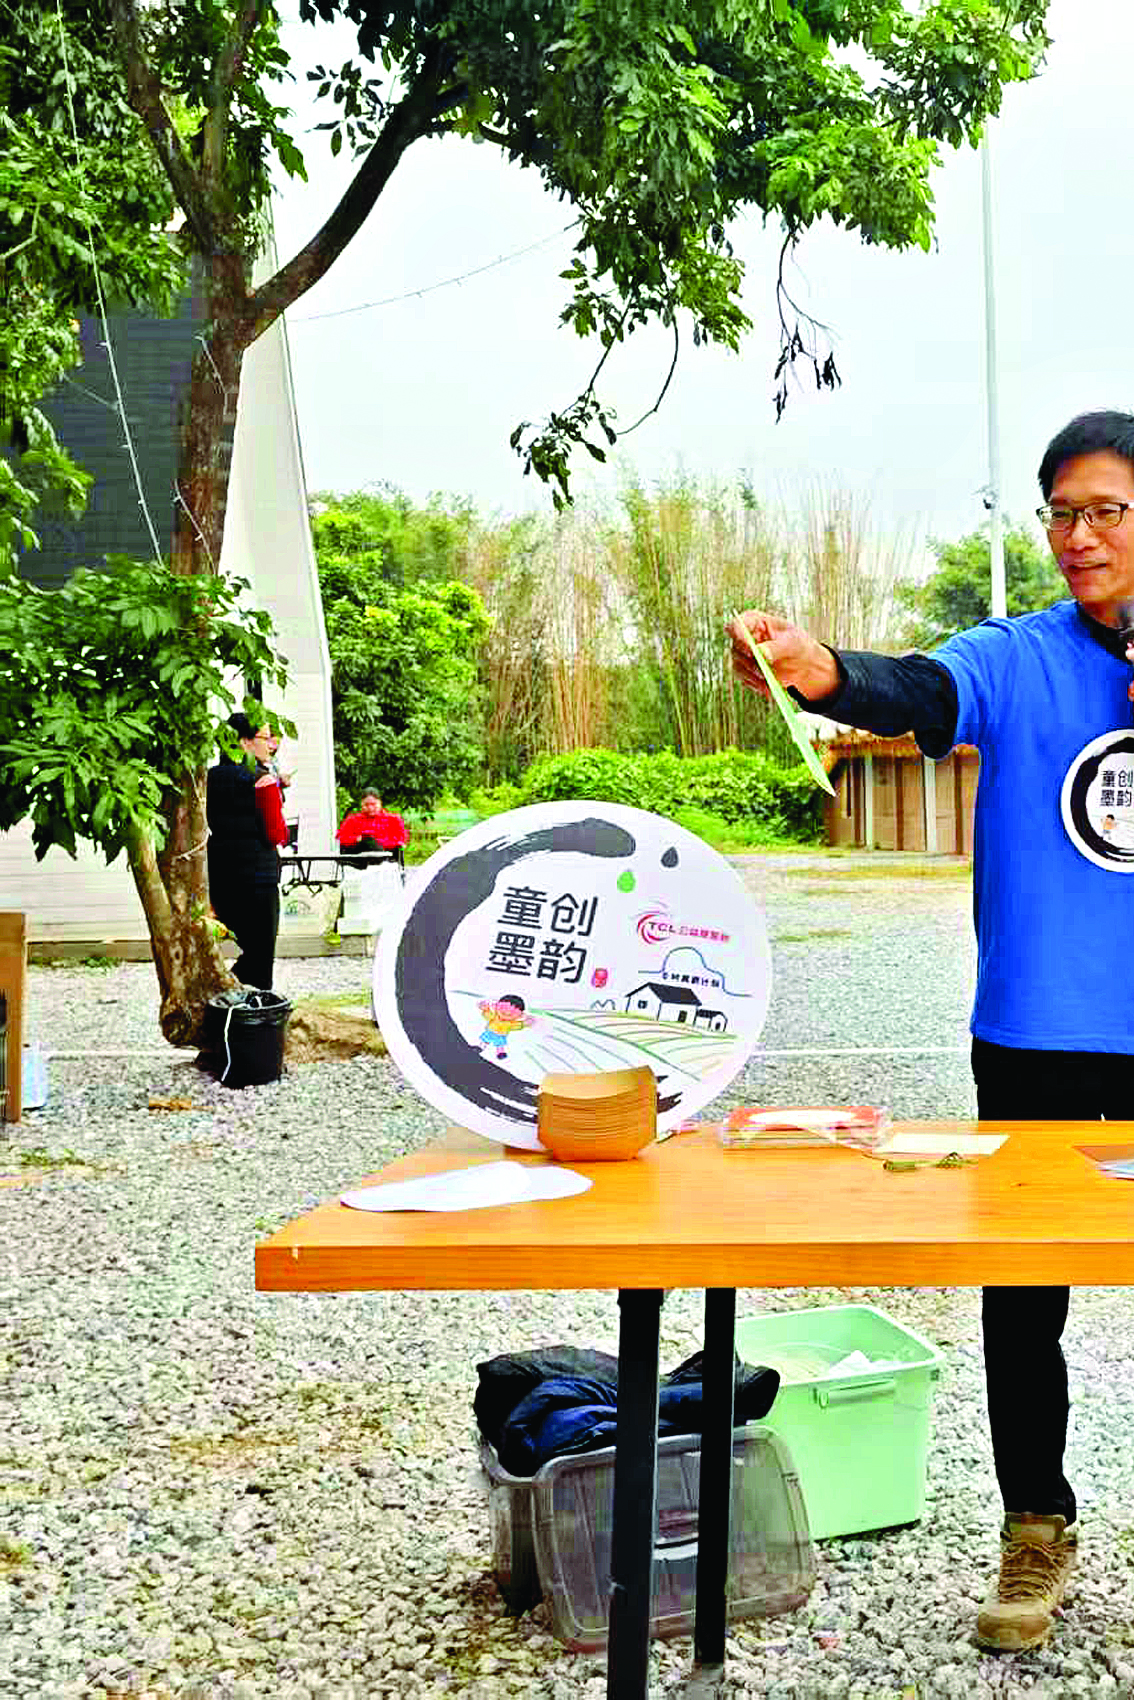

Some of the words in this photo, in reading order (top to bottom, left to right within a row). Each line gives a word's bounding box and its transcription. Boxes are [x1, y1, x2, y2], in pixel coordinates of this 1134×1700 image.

[1100, 769, 1134, 788] 童创
[497, 886, 599, 937] 童创
[485, 931, 588, 984] 墨韵
